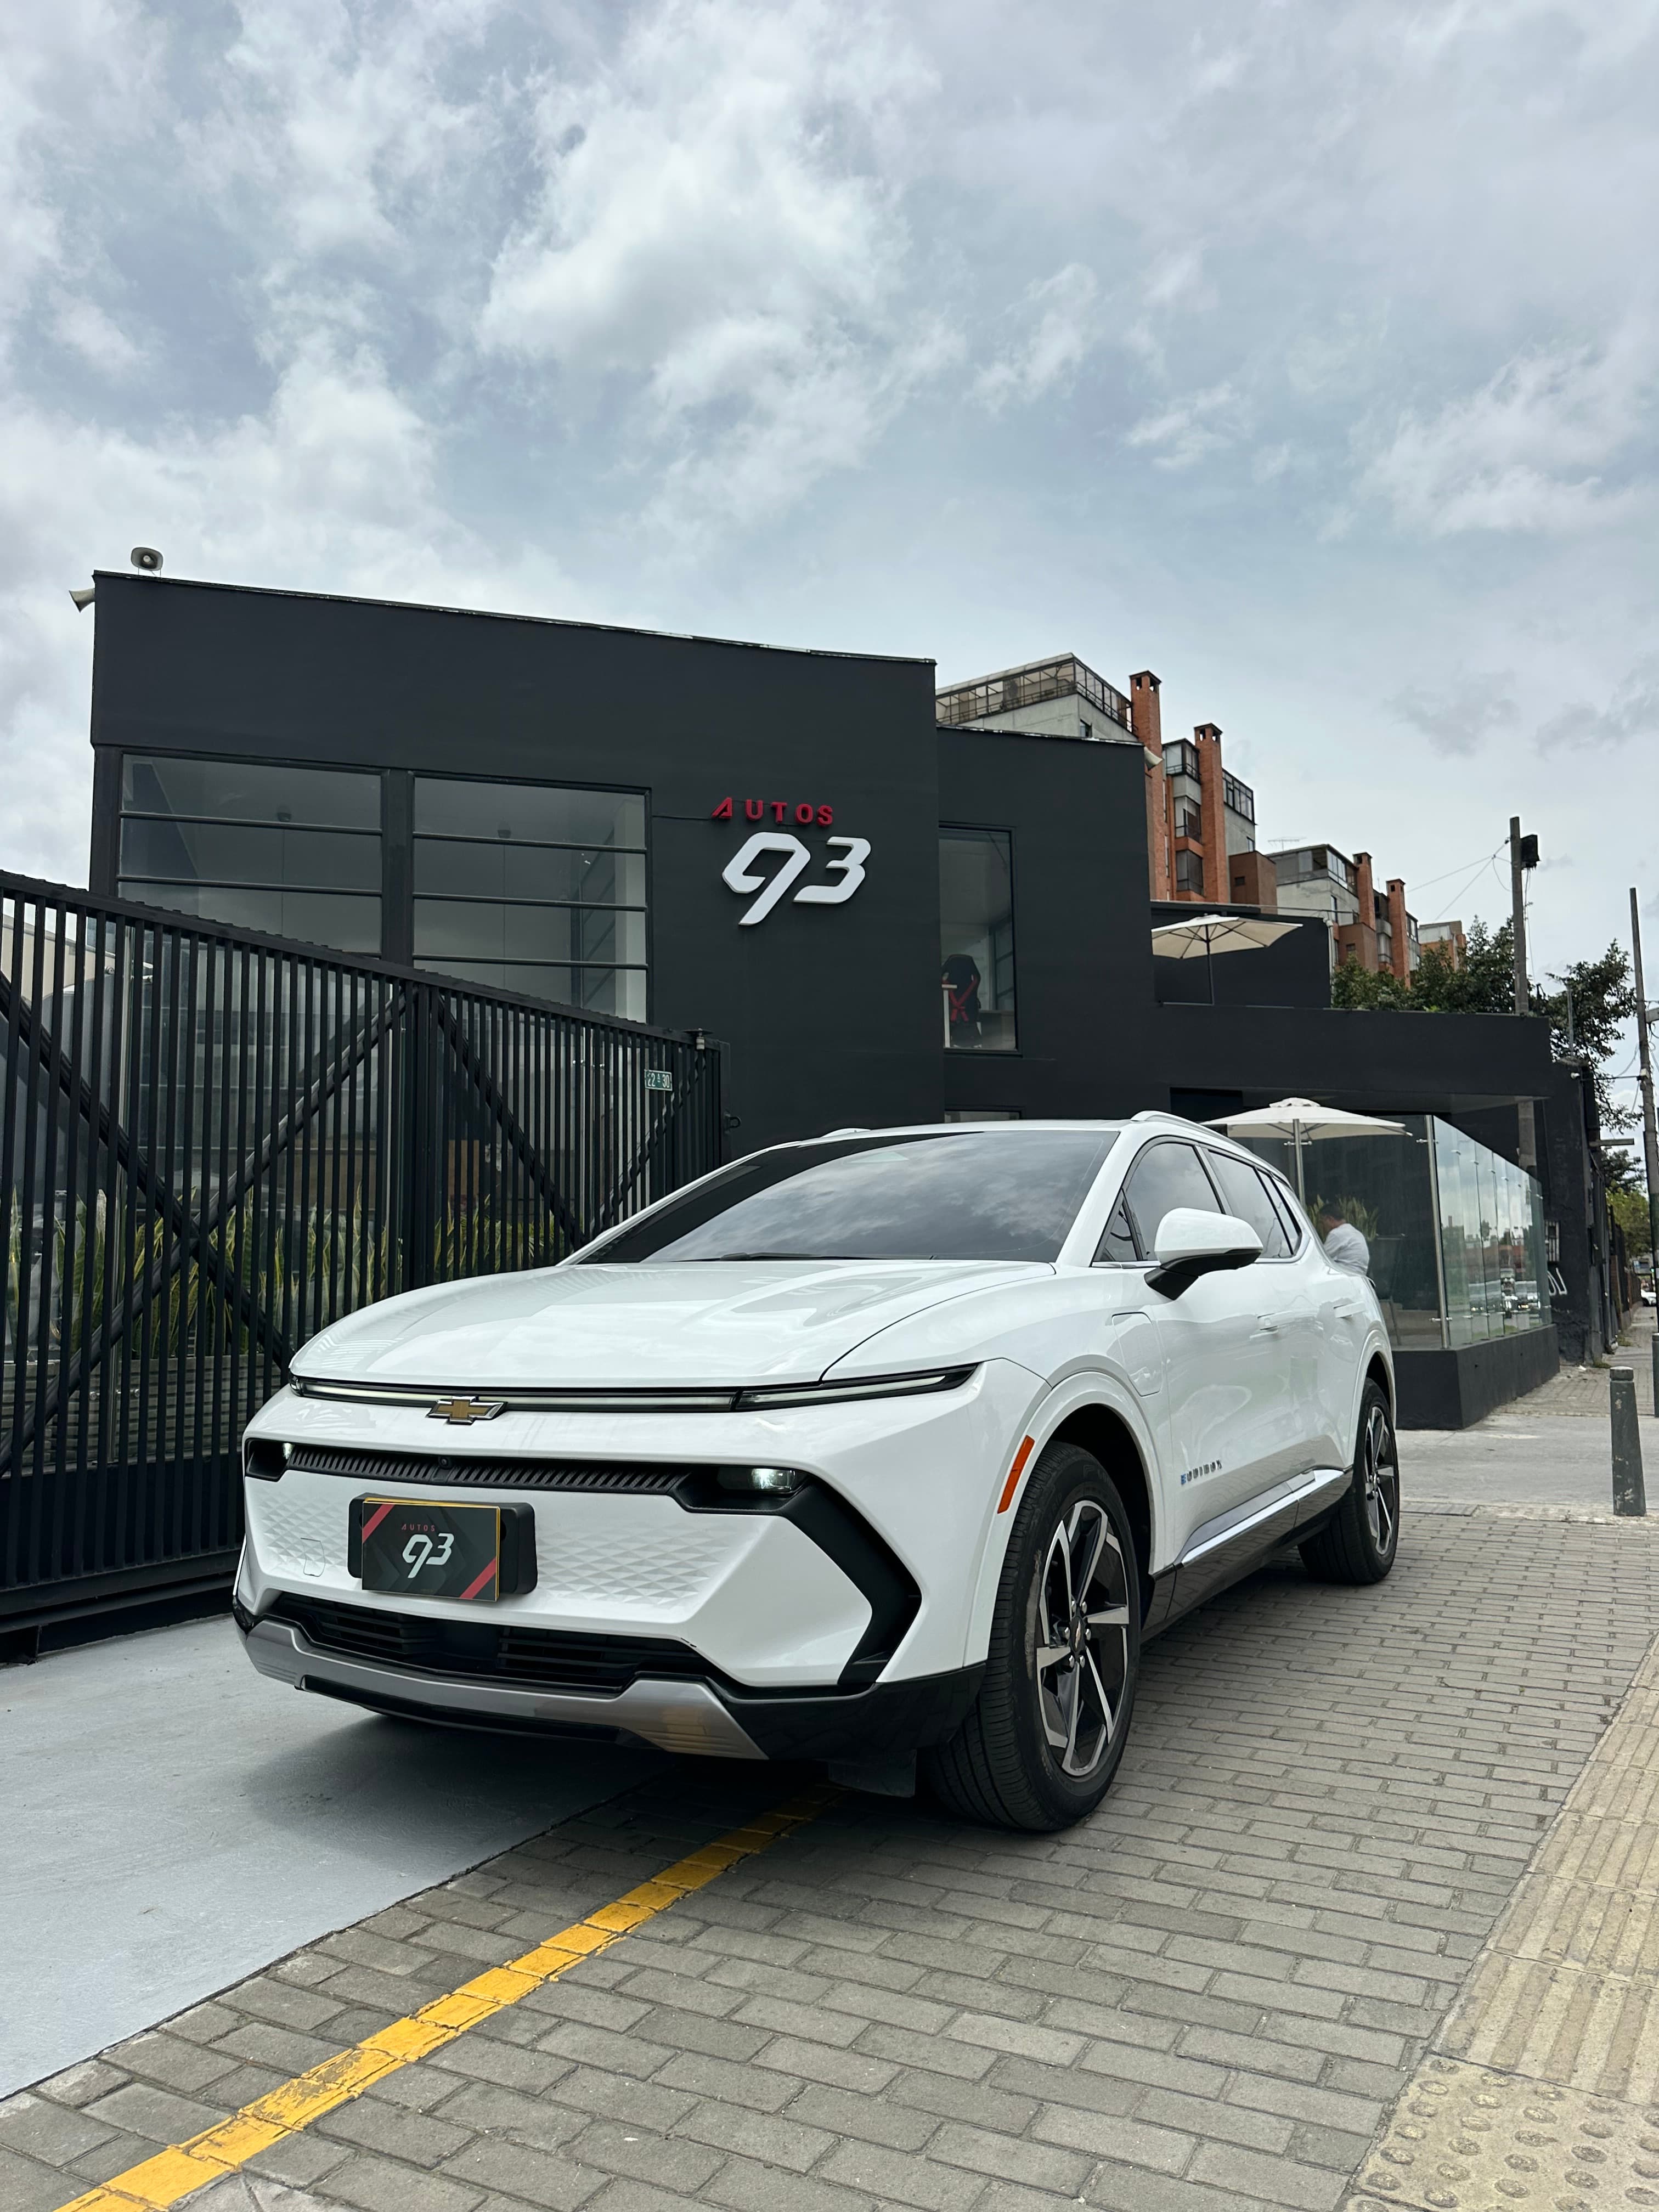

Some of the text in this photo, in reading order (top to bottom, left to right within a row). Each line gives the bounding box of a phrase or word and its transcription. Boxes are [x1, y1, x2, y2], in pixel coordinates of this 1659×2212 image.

[712, 797, 833, 826] AUTOS
[722, 832, 871, 926] 93
[401, 1523, 435, 1532] AUTOS
[402, 1533, 454, 1578] 93
